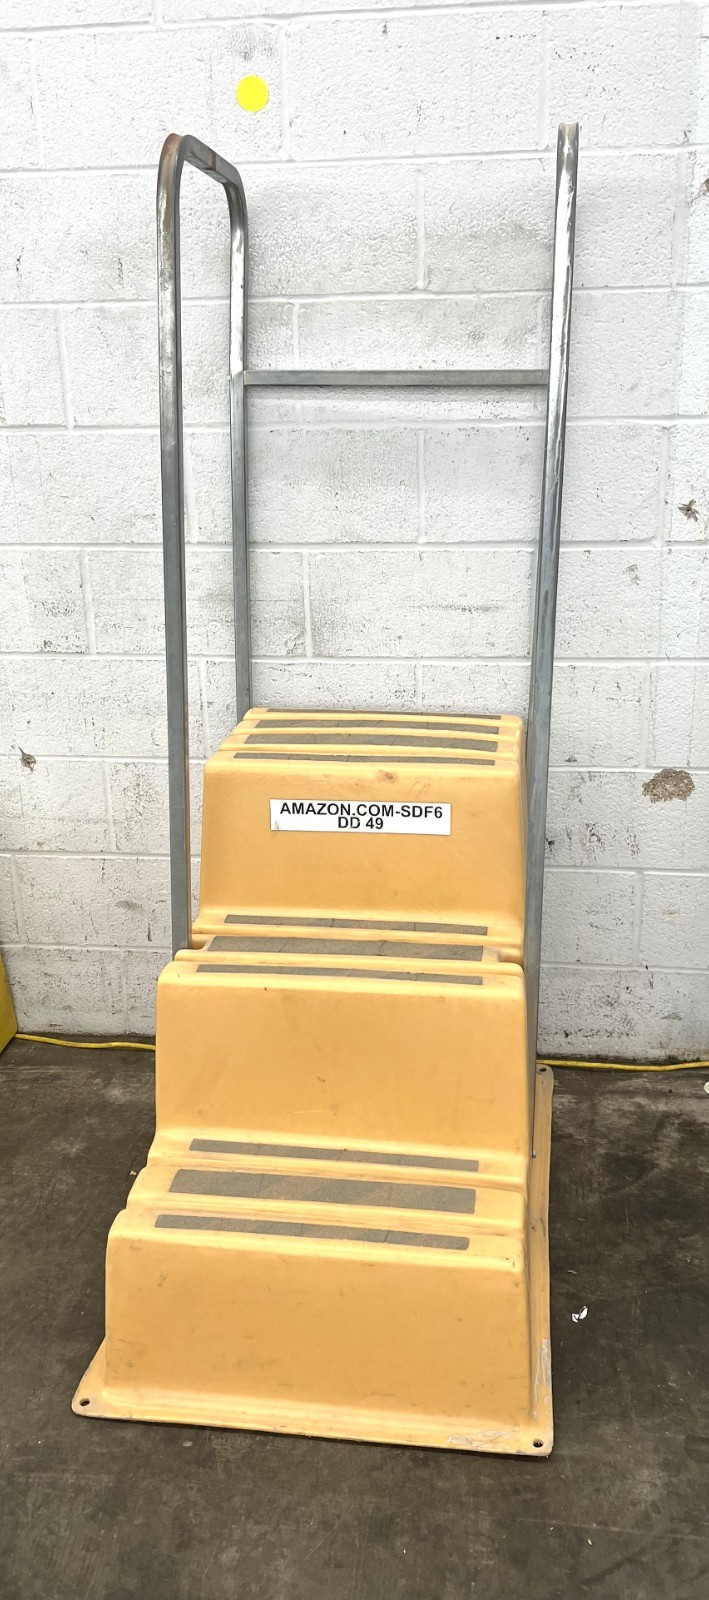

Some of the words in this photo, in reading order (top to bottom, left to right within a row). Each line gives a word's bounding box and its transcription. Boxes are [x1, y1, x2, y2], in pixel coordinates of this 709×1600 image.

[279, 802, 443, 819] AMAZON.COM-SDF6
[337, 816, 361, 829] DD
[365, 817, 384, 830] 49
